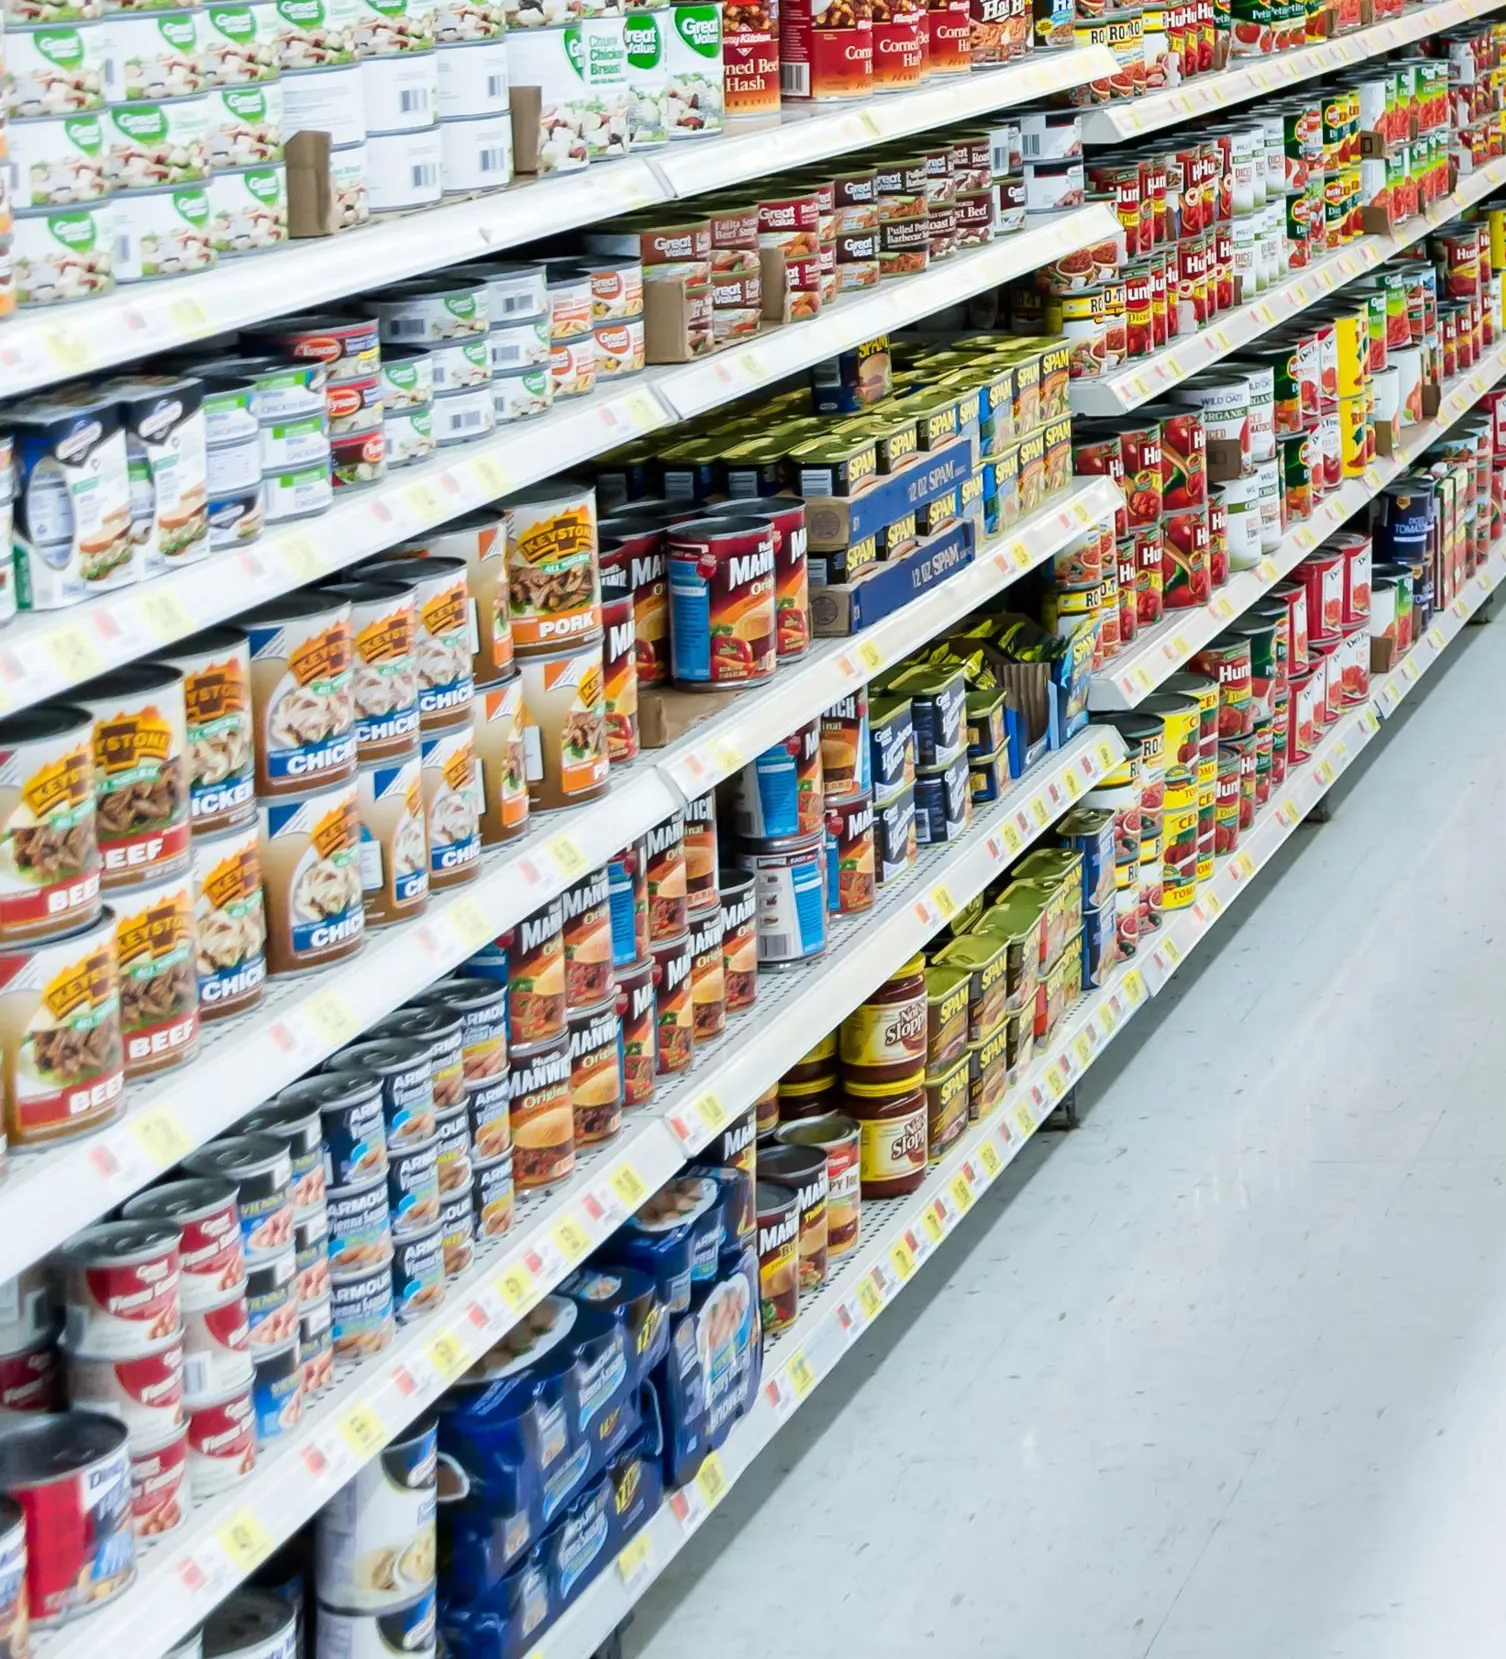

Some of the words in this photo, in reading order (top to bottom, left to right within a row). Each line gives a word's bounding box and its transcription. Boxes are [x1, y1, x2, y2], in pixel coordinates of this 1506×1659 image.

[681, 17, 720, 35] Great
[692, 31, 720, 45] Value
[726, 76, 766, 92] Hash
[759, 206, 797, 220] Great
[967, 204, 989, 218] Beef
[1042, 347, 1070, 373] SPAM
[1016, 364, 1040, 388] SPAM
[989, 378, 1013, 407] SPAM
[928, 409, 957, 438] SPAM
[1045, 421, 1071, 446] SPAM
[889, 430, 917, 459] SPAM
[1019, 439, 1044, 464] SPAM
[849, 450, 877, 481] SPAM
[928, 461, 956, 491] SPAM
[995, 454, 1018, 484] SPAM
[928, 494, 956, 525] SPAM
[887, 516, 916, 547] SPAM
[847, 537, 877, 570] SPAM
[931, 546, 960, 576] SPAM
[538, 612, 596, 639] PORK
[981, 954, 1007, 990] SPAM
[940, 986, 969, 1025] SPAM
[128, 1023, 194, 1060] BEEF
[980, 1032, 1007, 1069] SPAM
[940, 1066, 969, 1104] SPAM
